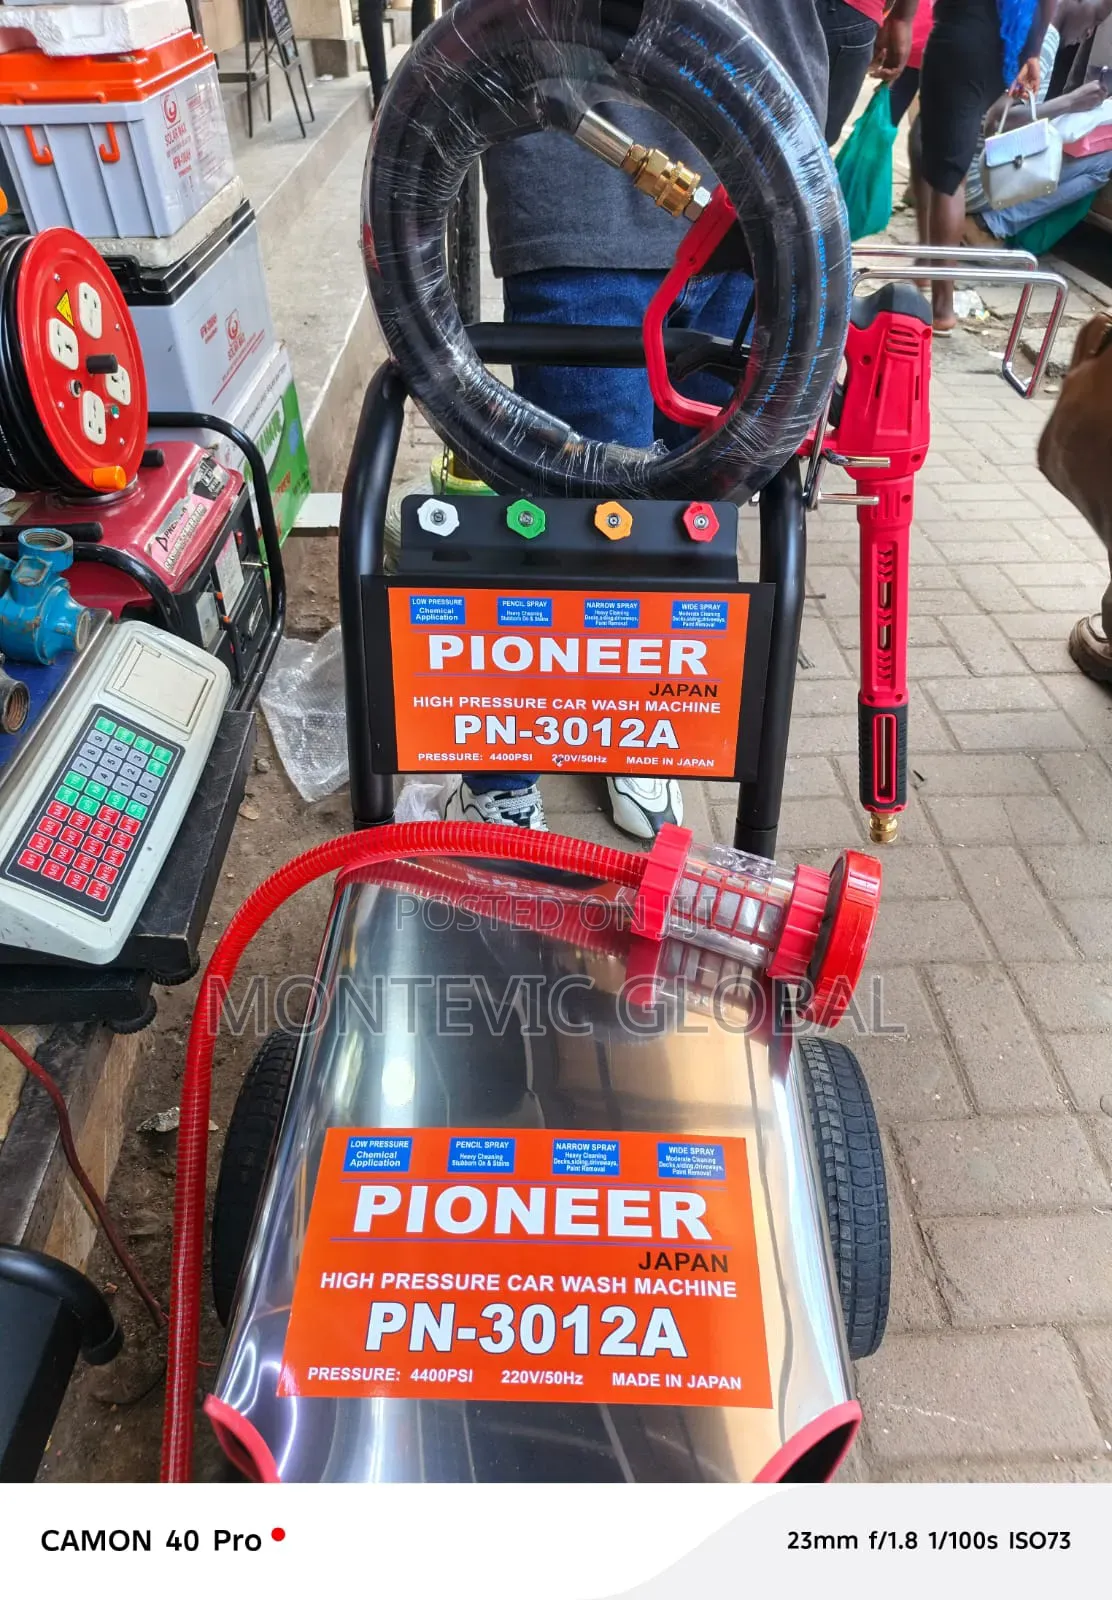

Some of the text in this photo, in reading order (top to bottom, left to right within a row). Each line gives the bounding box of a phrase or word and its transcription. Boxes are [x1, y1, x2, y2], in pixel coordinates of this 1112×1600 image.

[428, 598, 463, 606] PRESSURE
[699, 603, 721, 611] SPRAY
[415, 613, 458, 621] Application
[428, 635, 708, 675] PIONEER
[648, 683, 718, 698] JAPAN
[413, 696, 721, 714] HIGH PRESSURE CAR WASH MACHINE
[454, 714, 680, 749] PN-3012A
[418, 753, 533, 762] PRESSURE: 4400PSI
[626, 755, 715, 768] MADE IN JAPAN
[350, 1140, 409, 1148] LOW PRESSURE
[456, 1141, 509, 1149] PENCIL SPRAY
[556, 1142, 617, 1151] NARROW SPRAY
[668, 1146, 715, 1156] WIDE SPRAY
[356, 1151, 397, 1159] Chemical
[350, 1158, 401, 1167] Application
[353, 1185, 712, 1240] PIONEER
[638, 1251, 729, 1273] JAPAN
[320, 1272, 738, 1298] HIGH PRESSURE CAR WASH MACHINE
[364, 1301, 689, 1358] PN-3012A
[307, 1367, 473, 1383] PRESSURE: 4400PSI
[501, 1369, 584, 1386] 220V/50Hz
[612, 1371, 742, 1390] MADE IN JAPAN
